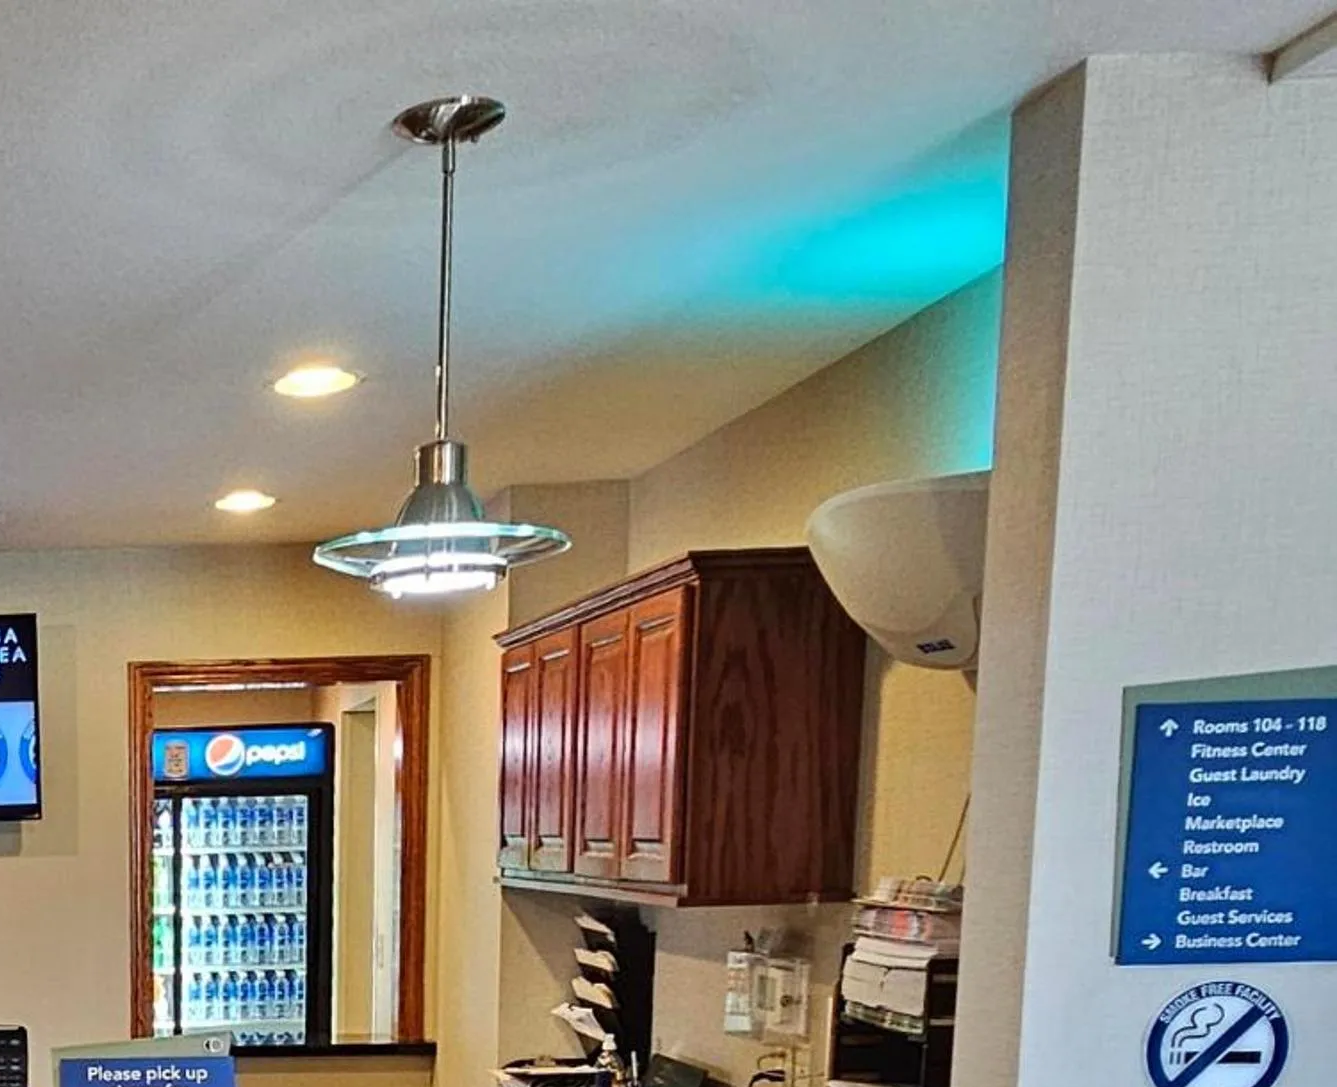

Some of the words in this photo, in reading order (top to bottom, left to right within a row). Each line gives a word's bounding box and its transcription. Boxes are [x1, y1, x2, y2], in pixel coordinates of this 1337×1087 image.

[3, 627, 18, 644] A
[12, 645, 27, 663] A
[1193, 719, 1249, 734] Rooms
[1253, 717, 1282, 733] 104
[1297, 716, 1327, 732] 118
[245, 741, 307, 767] pepsi
[1190, 743, 1247, 759] Fitness
[1251, 742, 1306, 757] Center
[1189, 767, 1237, 783] Guest
[1241, 765, 1306, 785] Laundry
[1187, 793, 1212, 807] Ice
[1184, 815, 1284, 833] Marketplace
[1182, 840, 1260, 855] Restroom
[1181, 864, 1209, 878] Bar
[1179, 886, 1254, 902] Breakfast
[1177, 911, 1225, 926] Guest
[1227, 909, 1293, 925] Services
[1175, 934, 1242, 950] Business
[1245, 932, 1302, 948] Center
[1159, 990, 1201, 1025] SMOKE
[1200, 983, 1234, 998] FREE
[1234, 984, 1281, 1020] FACILITY
[87, 1066, 142, 1082] Please
[146, 1065, 181, 1085] pick
[185, 1068, 209, 1085] up
